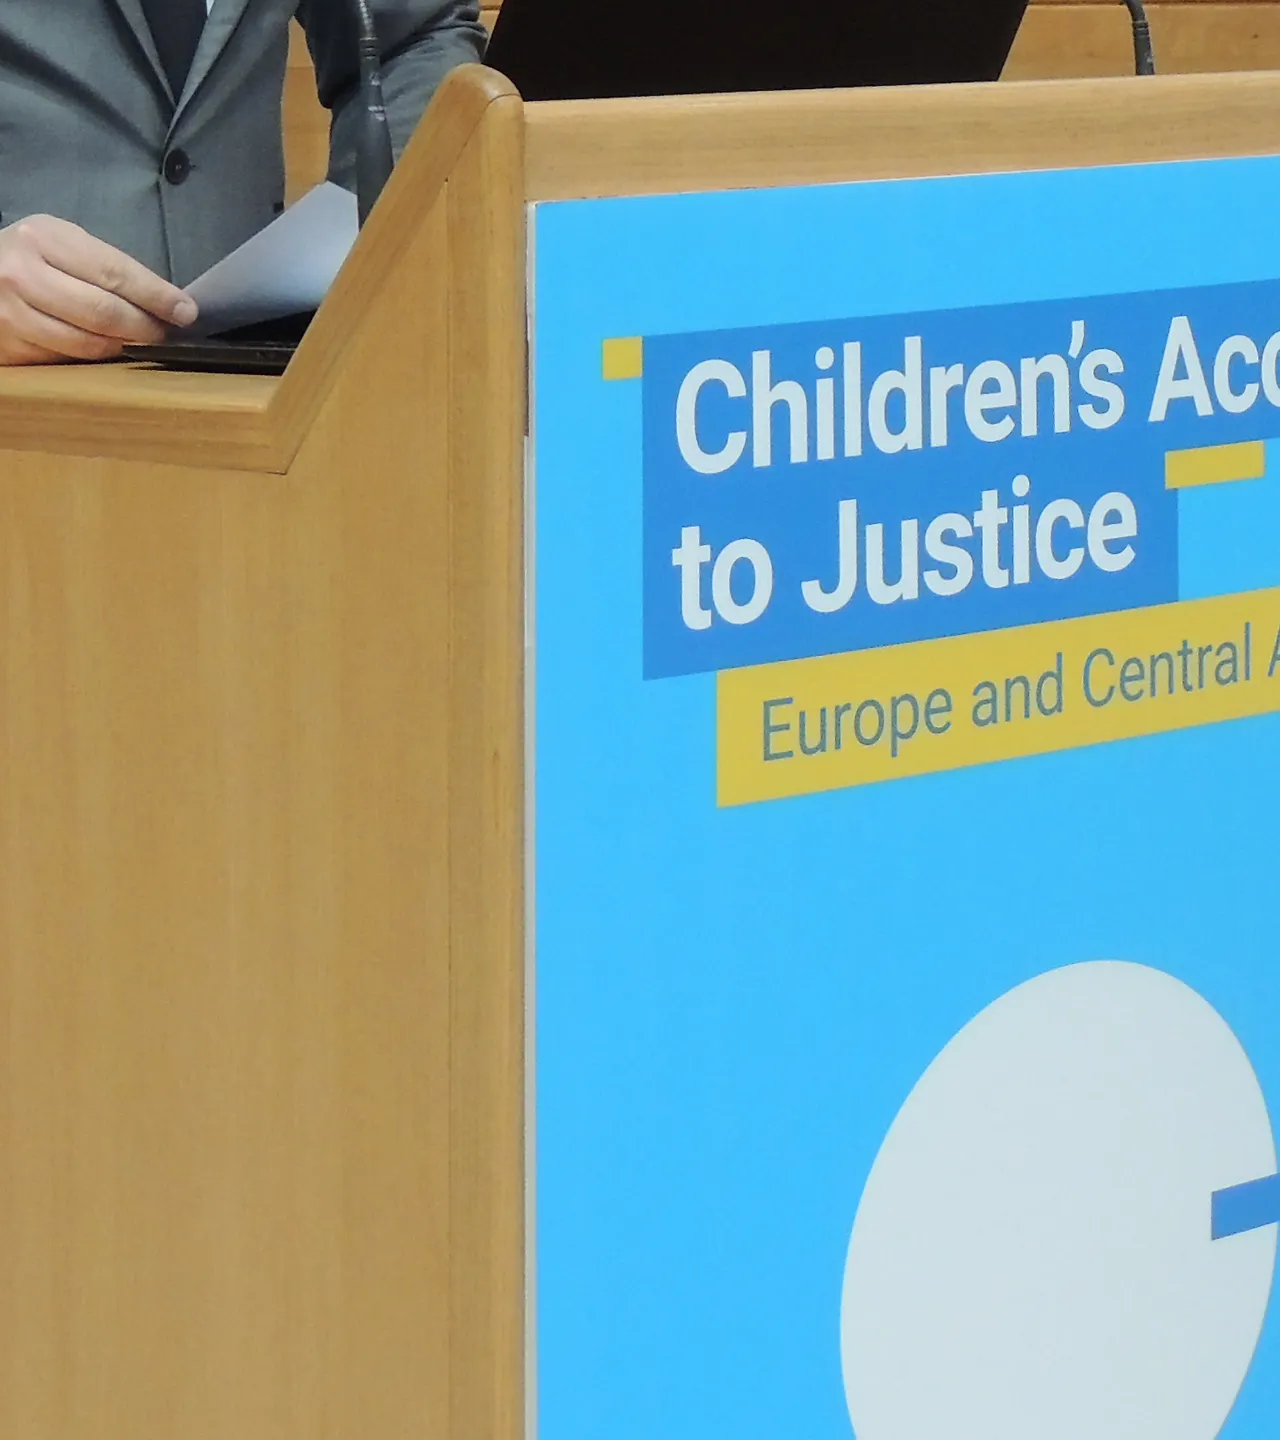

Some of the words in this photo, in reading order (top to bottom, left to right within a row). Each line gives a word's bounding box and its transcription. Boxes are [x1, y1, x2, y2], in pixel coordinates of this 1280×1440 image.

[672, 524, 772, 632] to
[801, 474, 1138, 615] Justice
[762, 688, 952, 762] Europe
[972, 652, 1063, 727] and
[1082, 624, 1252, 707] Central
